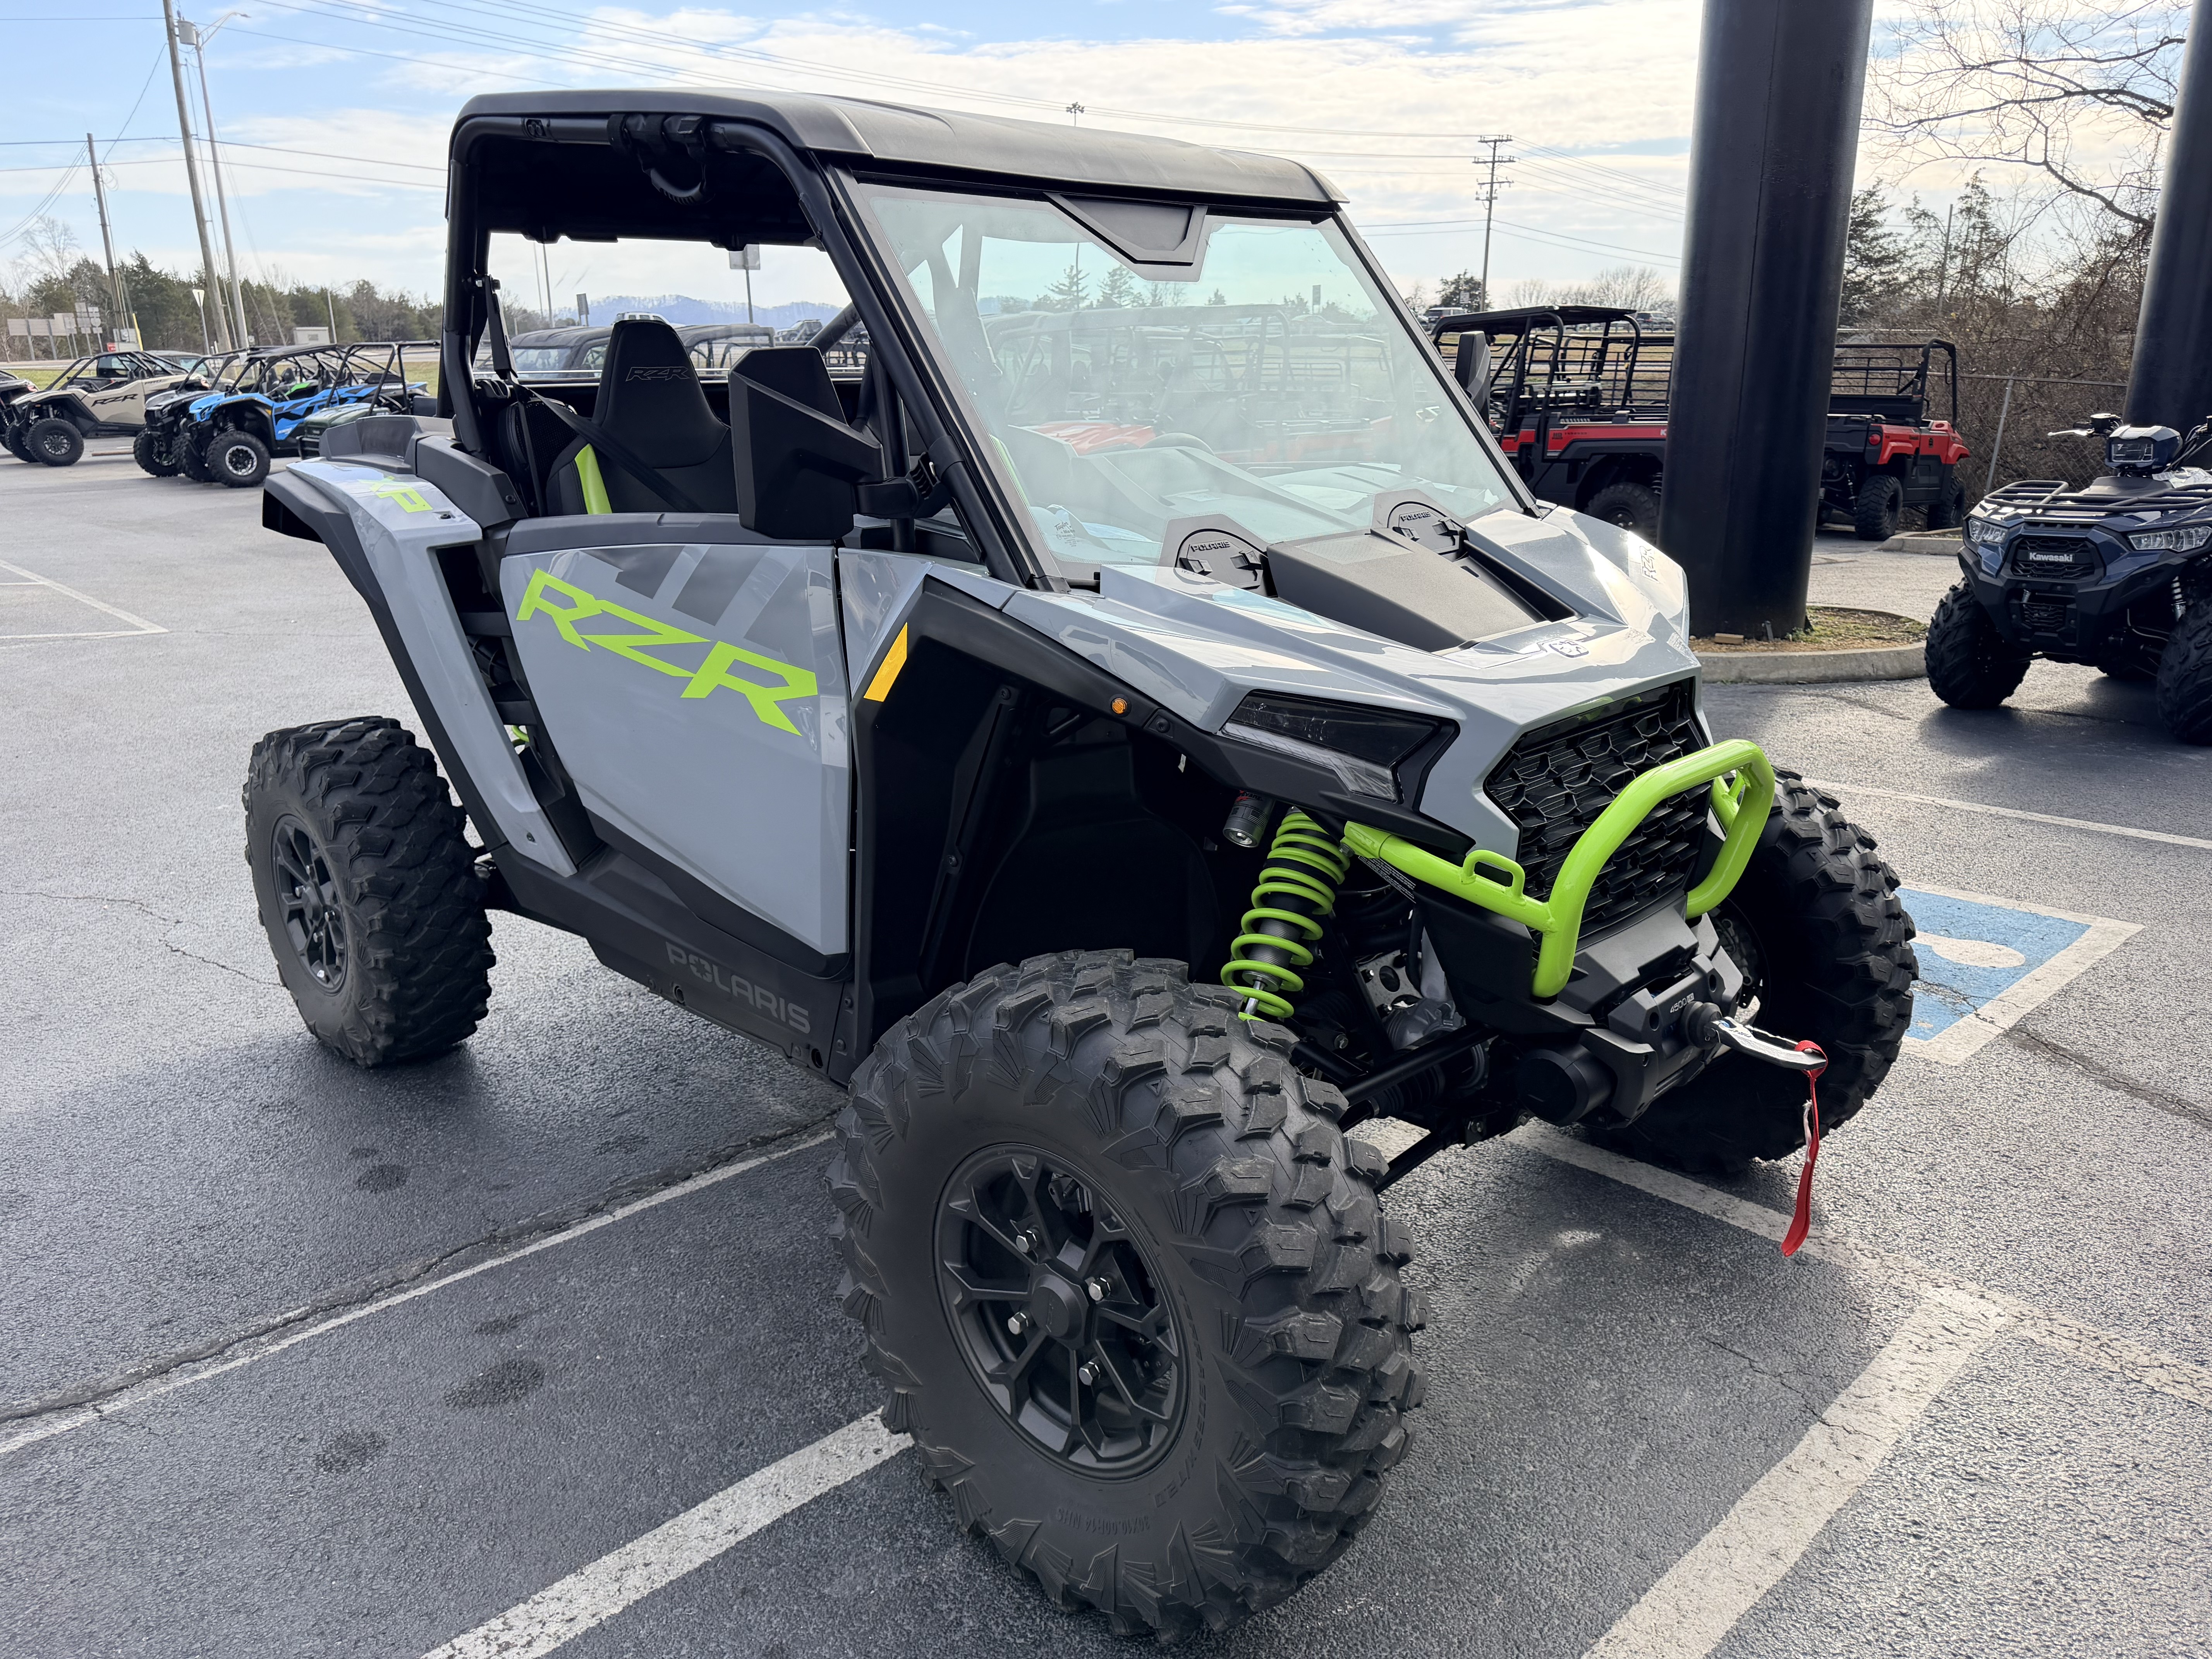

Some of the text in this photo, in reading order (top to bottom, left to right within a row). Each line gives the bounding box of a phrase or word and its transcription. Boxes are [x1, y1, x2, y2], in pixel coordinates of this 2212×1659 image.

[625, 366, 691, 381] RZR
[91, 394, 138, 407] RZR
[1400, 510, 1431, 522] POLARIS
[1054, 521, 1068, 531] Taylor
[1190, 541, 1231, 552] POLARIS
[2029, 551, 2074, 562] Kawasaki
[1639, 546, 1660, 584] RZR
[516, 568, 818, 737] RZR
[665, 941, 811, 1034] POLARIS
[1670, 998, 1687, 1013] 4500
